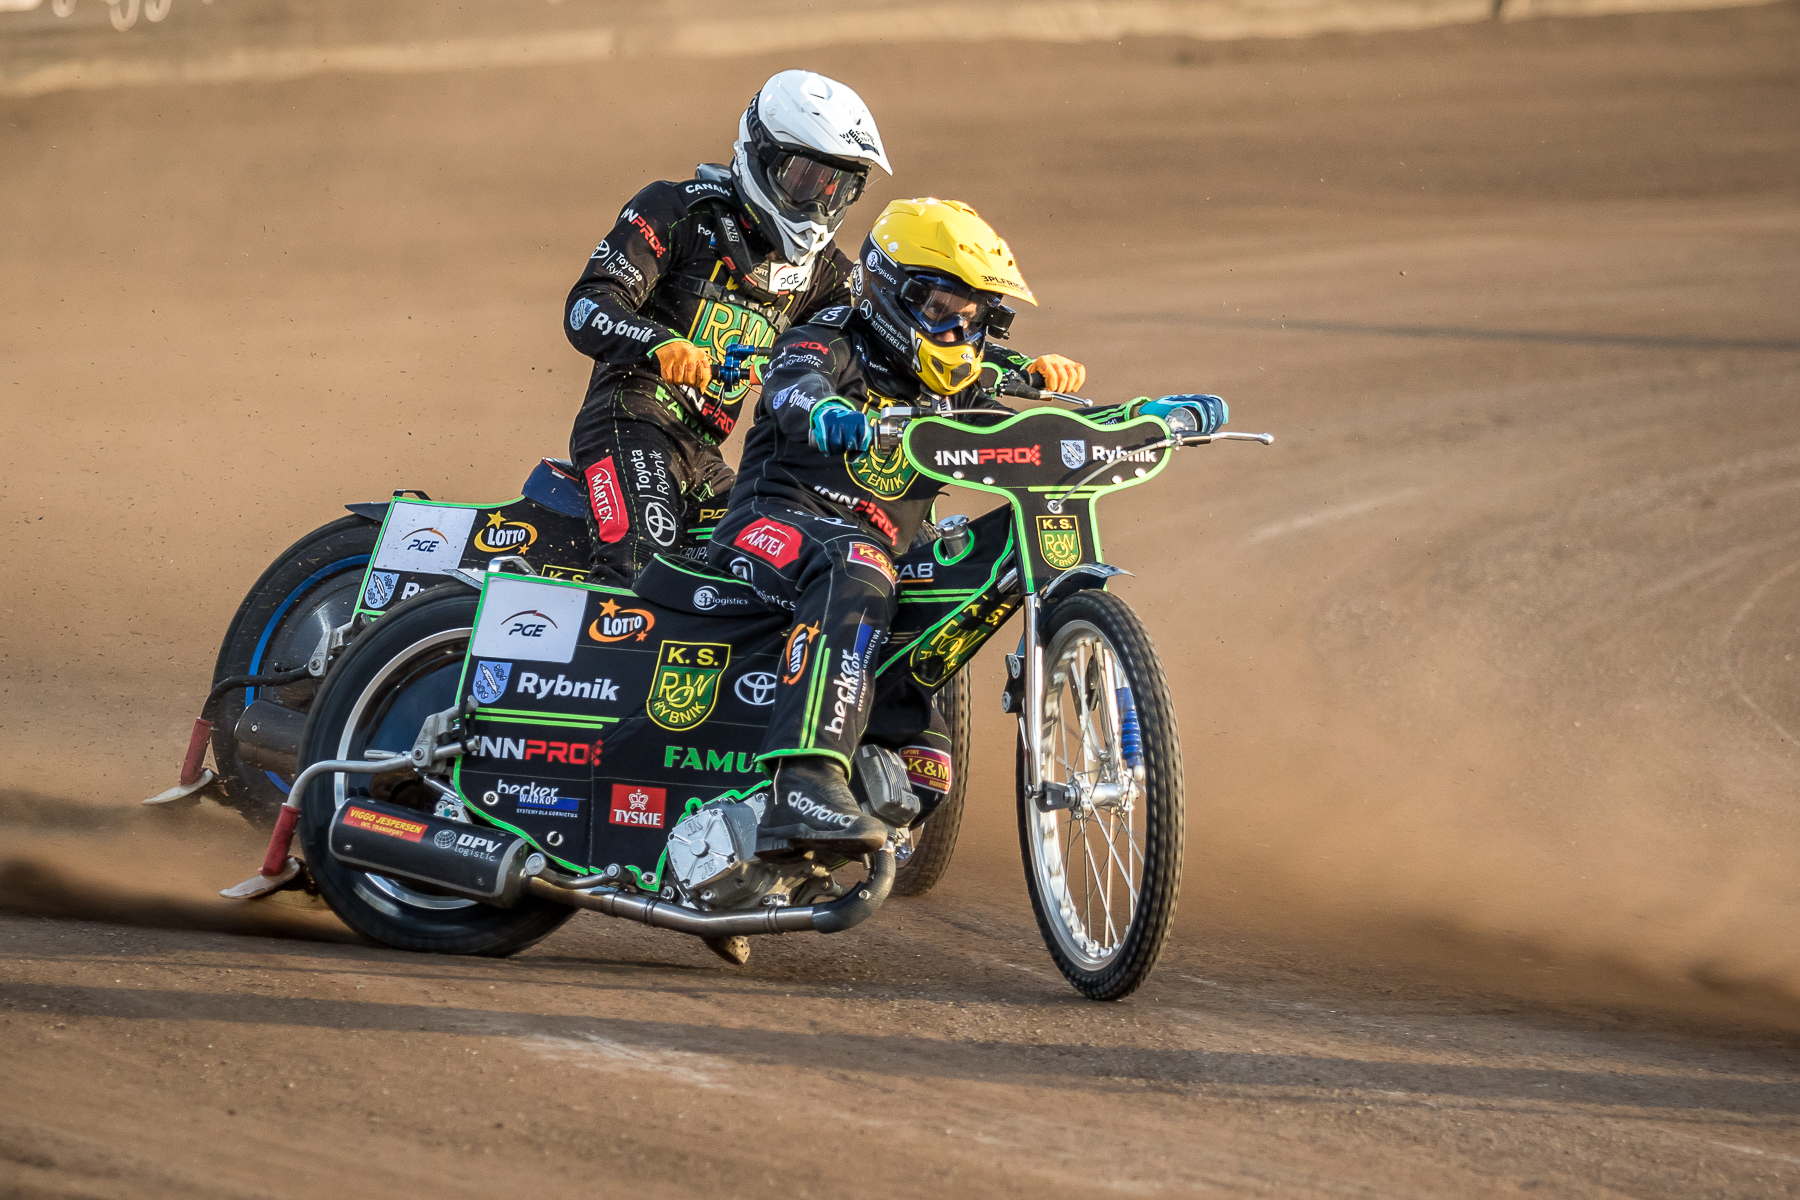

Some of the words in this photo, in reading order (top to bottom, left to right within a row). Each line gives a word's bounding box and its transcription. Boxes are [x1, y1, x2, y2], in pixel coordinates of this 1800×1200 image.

[606, 262, 635, 288] Rybnik
[615, 252, 643, 282] Toyota
[591, 311, 657, 343] Rybnik
[871, 321, 887, 337] AUTO
[885, 334, 908, 354] FRELIK
[875, 312, 910, 345] Mercedes-Benz
[934, 445, 1036, 466] INNPRO
[1092, 445, 1157, 464] Rybnik
[631, 449, 651, 493] Toyota
[649, 450, 669, 495] Rybnik
[857, 458, 905, 492] YBNIK
[591, 473, 614, 525] MARTEX
[407, 540, 440, 553] PGE
[741, 529, 786, 558] MARTEX
[1046, 552, 1077, 567] RYBNIK
[712, 595, 749, 606] logistics
[508, 623, 547, 637] PGE
[516, 672, 620, 701] Rybnik
[846, 652, 861, 705] WARKOP
[825, 648, 855, 734] becker
[653, 700, 706, 723] RYBNIK
[908, 757, 949, 781] K&M
[497, 779, 559, 798] becker
[519, 793, 559, 806] WARKOP
[350, 809, 376, 823] VIGGO
[375, 817, 423, 834] JESPERSEN
[516, 808, 538, 816] SYSTEMY
[613, 809, 662, 827] TYSKIE
[787, 791, 859, 828] daytona
[371, 823, 404, 837] TRANSPORT
[454, 843, 495, 862] logistic
[456, 833, 503, 854] DPV
